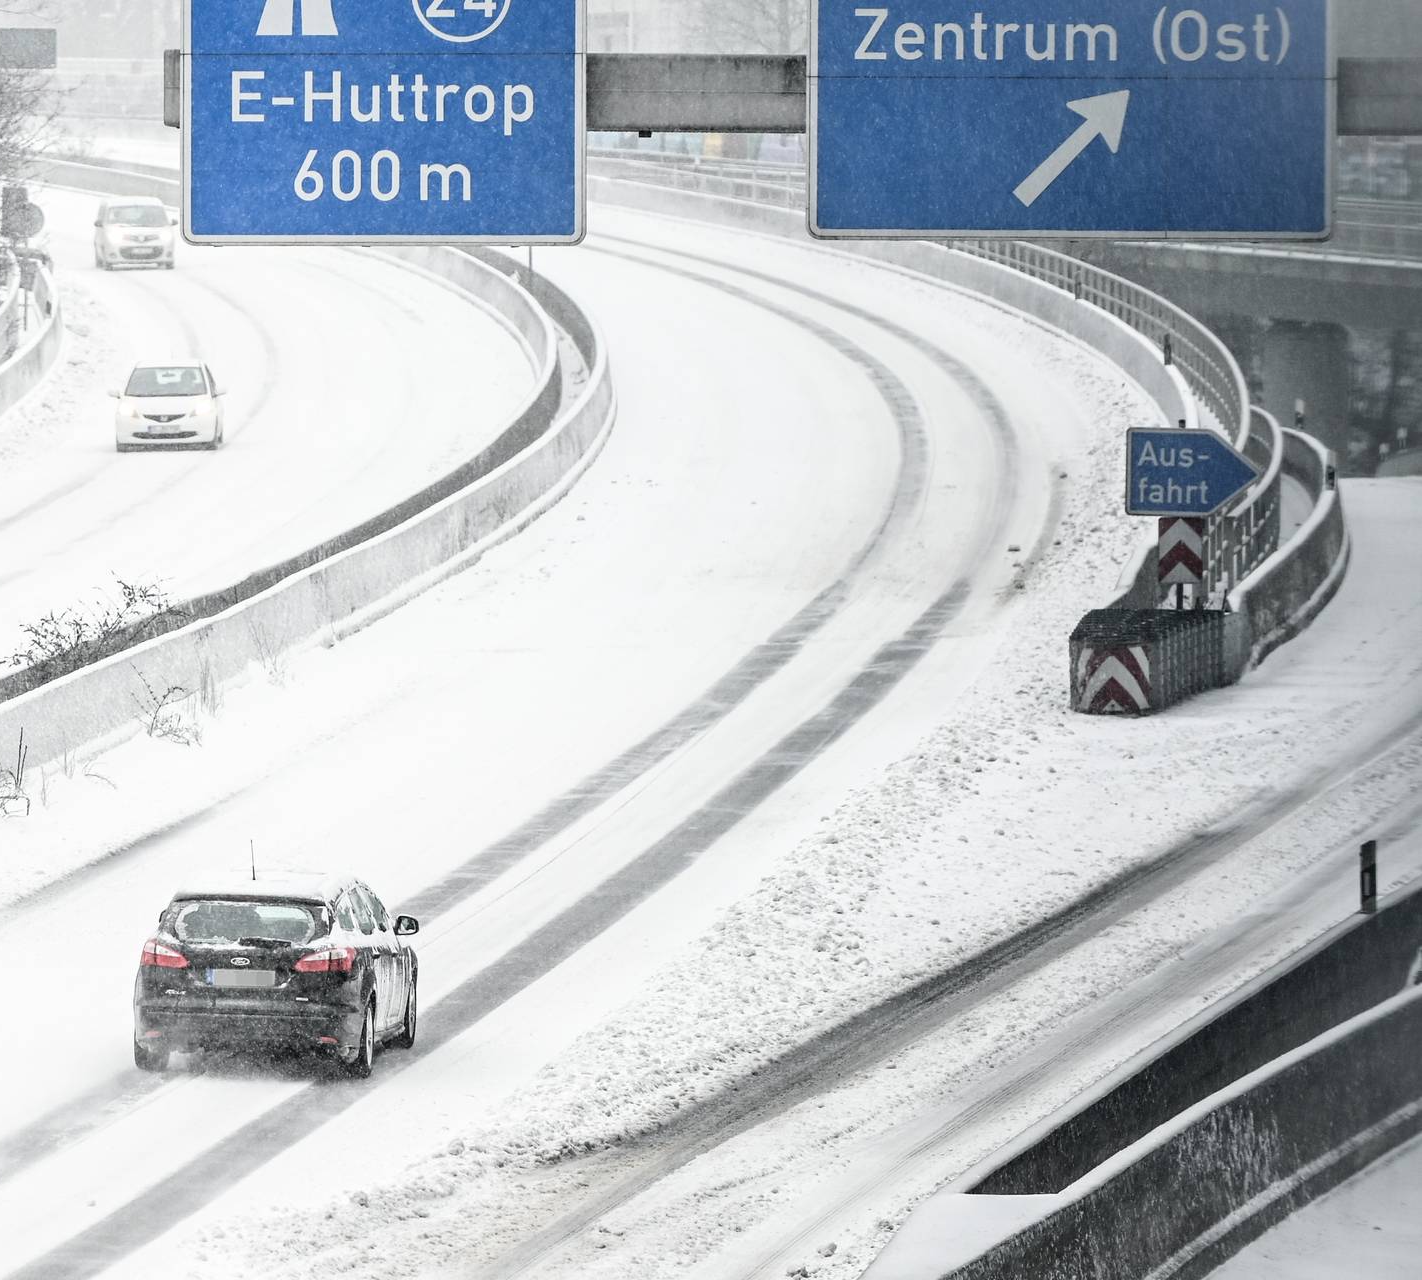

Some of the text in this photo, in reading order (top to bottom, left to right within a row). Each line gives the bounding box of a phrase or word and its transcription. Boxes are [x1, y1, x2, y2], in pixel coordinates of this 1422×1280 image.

[854, 6, 1291, 65] Zentrum (Ost)
[231, 70, 534, 136] E-Huttrop
[294, 149, 471, 202] 600 m
[1137, 440, 1210, 468] Aus-
[1138, 477, 1208, 504] fahrt
